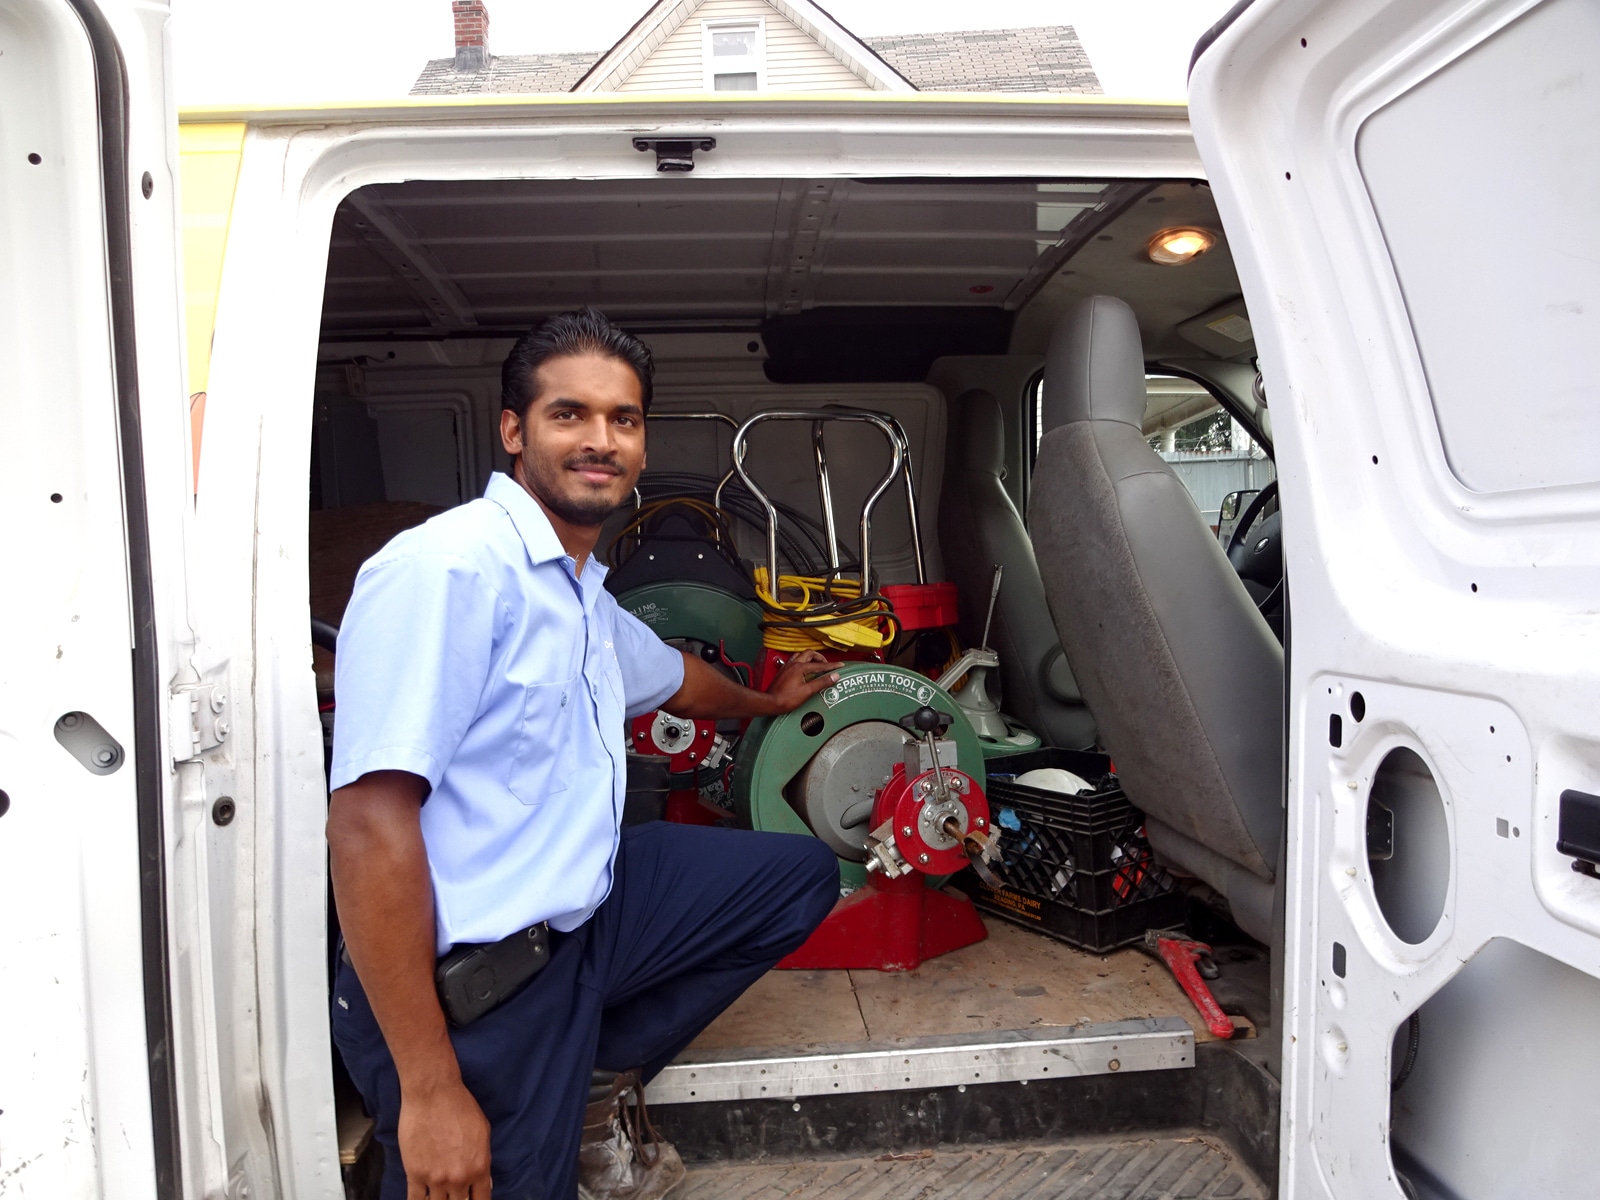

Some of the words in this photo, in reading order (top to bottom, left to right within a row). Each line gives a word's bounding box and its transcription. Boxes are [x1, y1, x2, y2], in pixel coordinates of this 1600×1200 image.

[836, 674, 885, 692] SPARTAN
[889, 674, 917, 691] TOOL
[1022, 897, 1041, 910] DAIRY
